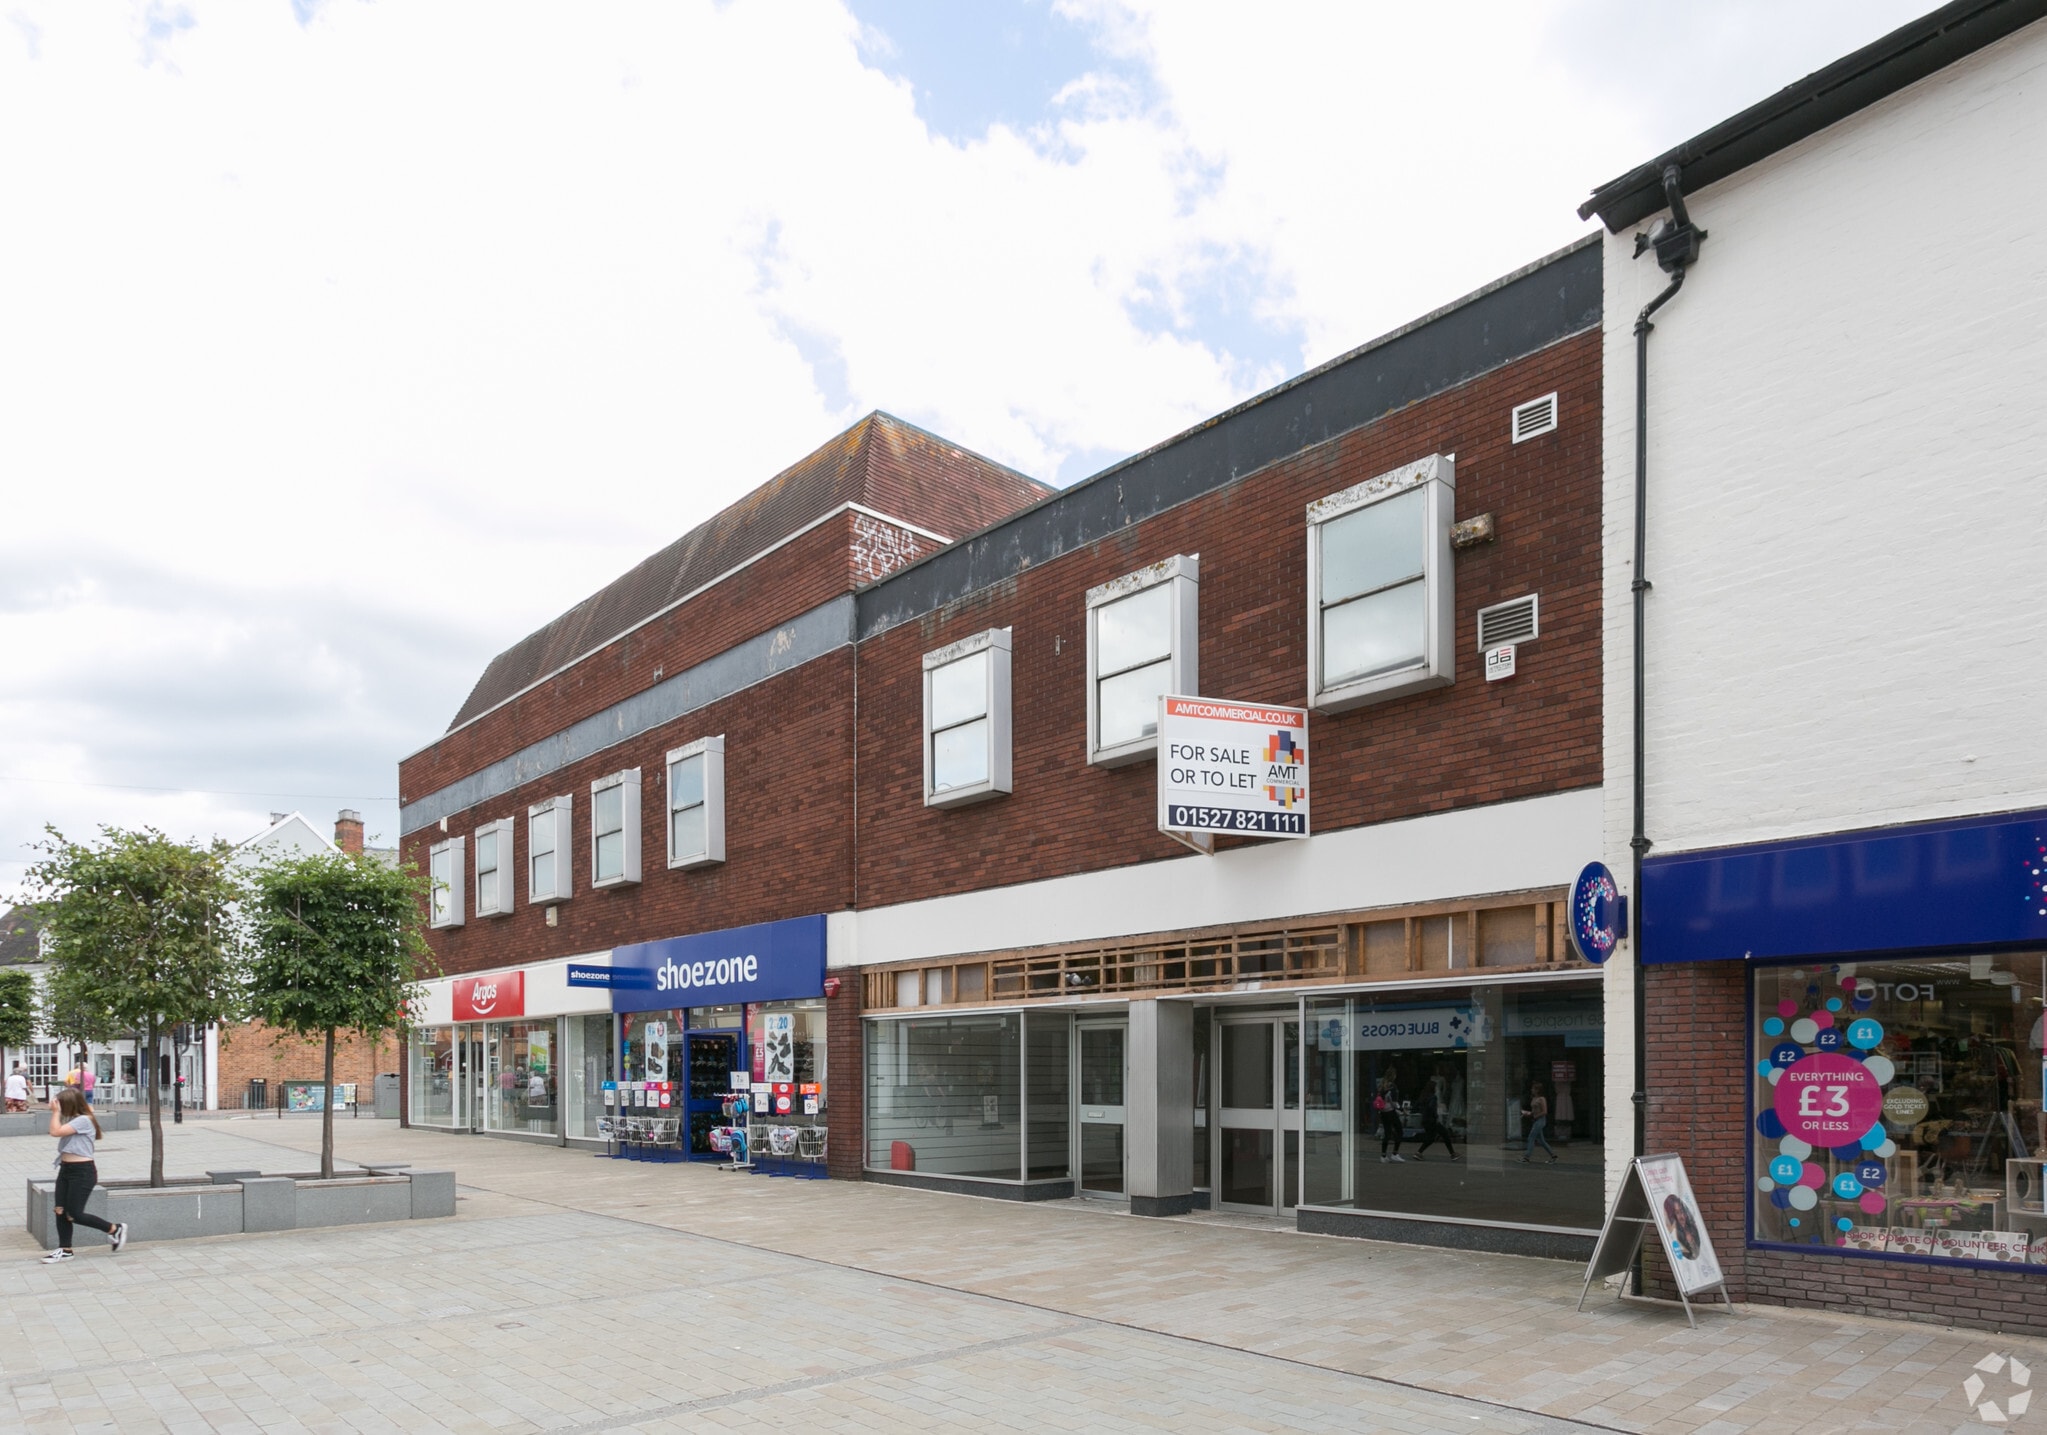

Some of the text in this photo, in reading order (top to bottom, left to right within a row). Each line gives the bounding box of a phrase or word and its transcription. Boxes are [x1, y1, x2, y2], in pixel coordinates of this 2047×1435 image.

[1175, 703, 1296, 725] AMTCOMMERCIAL.CO.UK
[1170, 744, 1250, 764] FOR SALE
[1268, 765, 1298, 780] AMT
[1170, 768, 1257, 789] OR TO LET
[1176, 807, 1299, 832] 01527 821 111
[570, 971, 610, 980] shoezone
[657, 954, 758, 991] shoezone
[472, 982, 497, 1006] Argos
[1820, 1034, 1836, 1044] £2
[1857, 1028, 1873, 1039] £1
[1778, 1051, 1795, 1062] £2
[1790, 1072, 1864, 1081] EVERYTHING
[1798, 1085, 1849, 1117] £3
[1802, 1121, 1849, 1130] OR LESS
[1778, 1164, 1794, 1175] £1
[1862, 1168, 1880, 1179] £2
[1840, 1180, 1855, 1191] £1
[1923, 1236, 1938, 1245] OR
